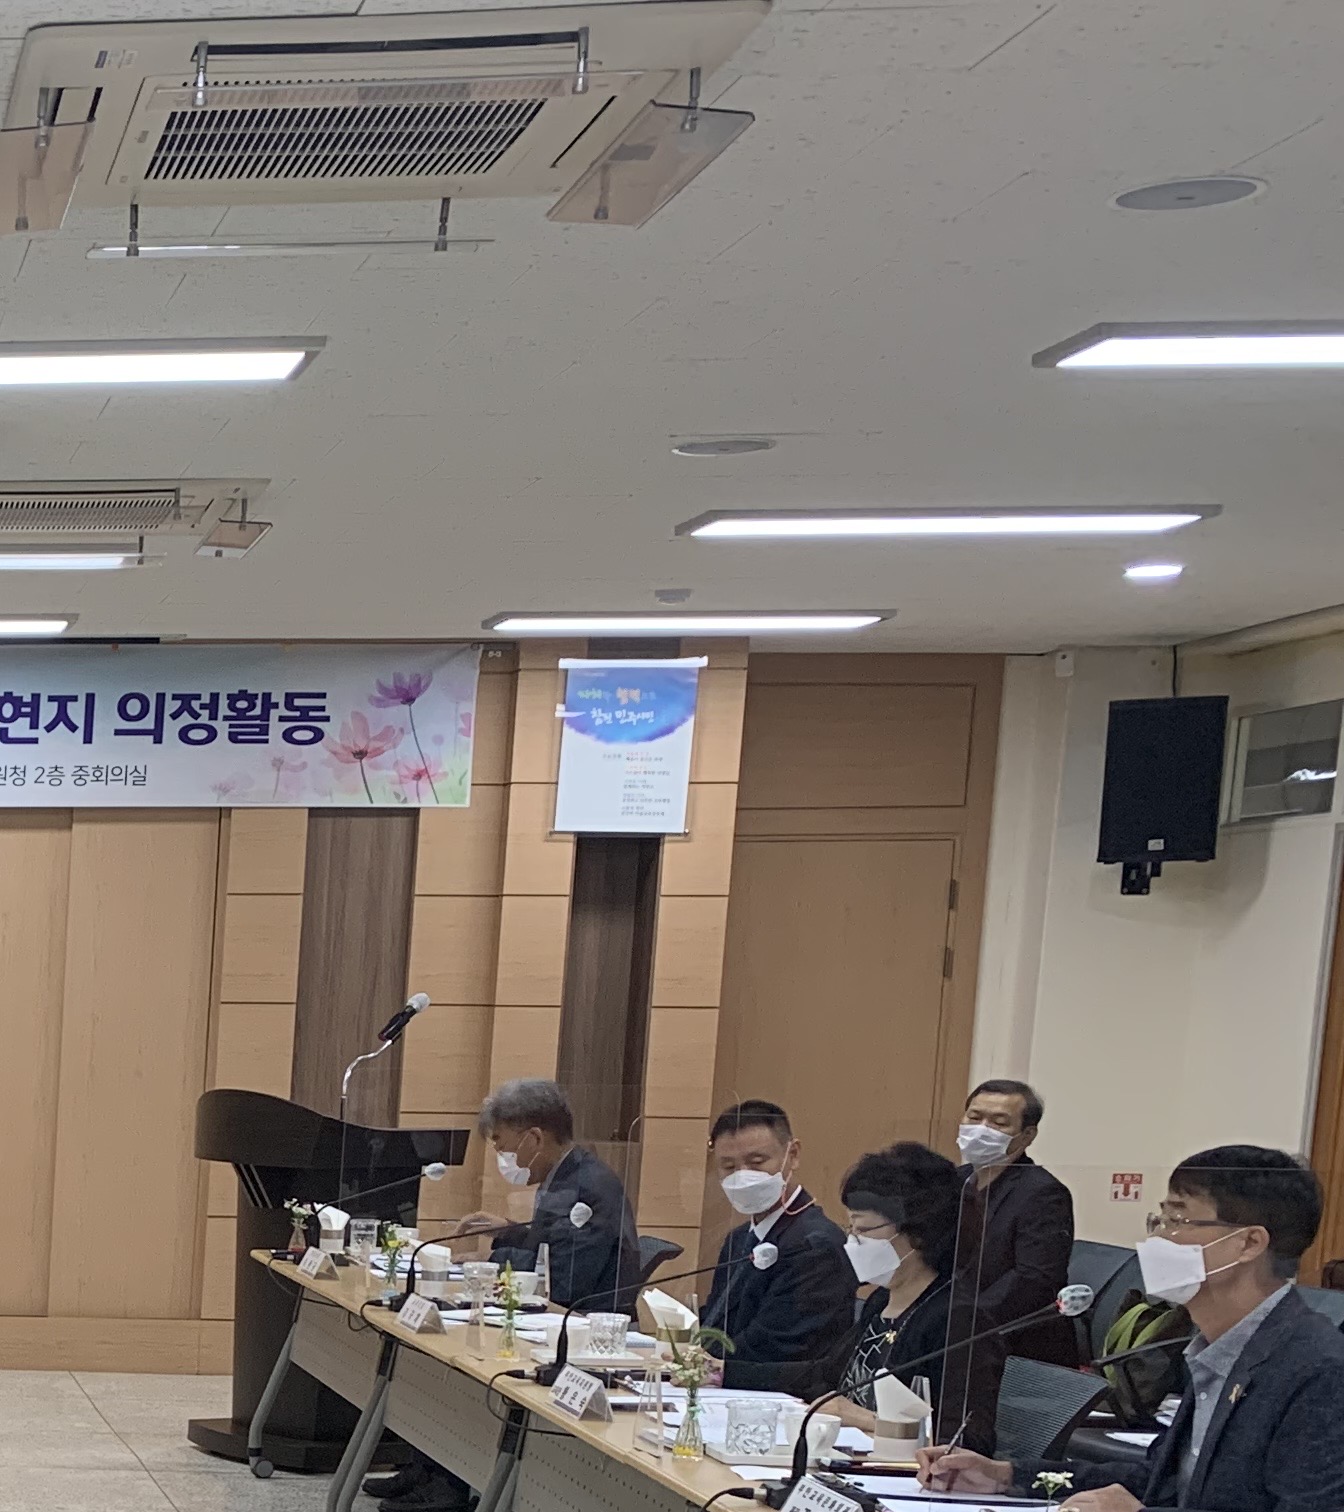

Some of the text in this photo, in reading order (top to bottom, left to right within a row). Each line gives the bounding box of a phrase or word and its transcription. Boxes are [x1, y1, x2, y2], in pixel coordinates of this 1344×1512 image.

[113, 689, 331, 747] 의정활동
[34, 765, 66, 787] 2층
[71, 764, 148, 788] 중회의실
